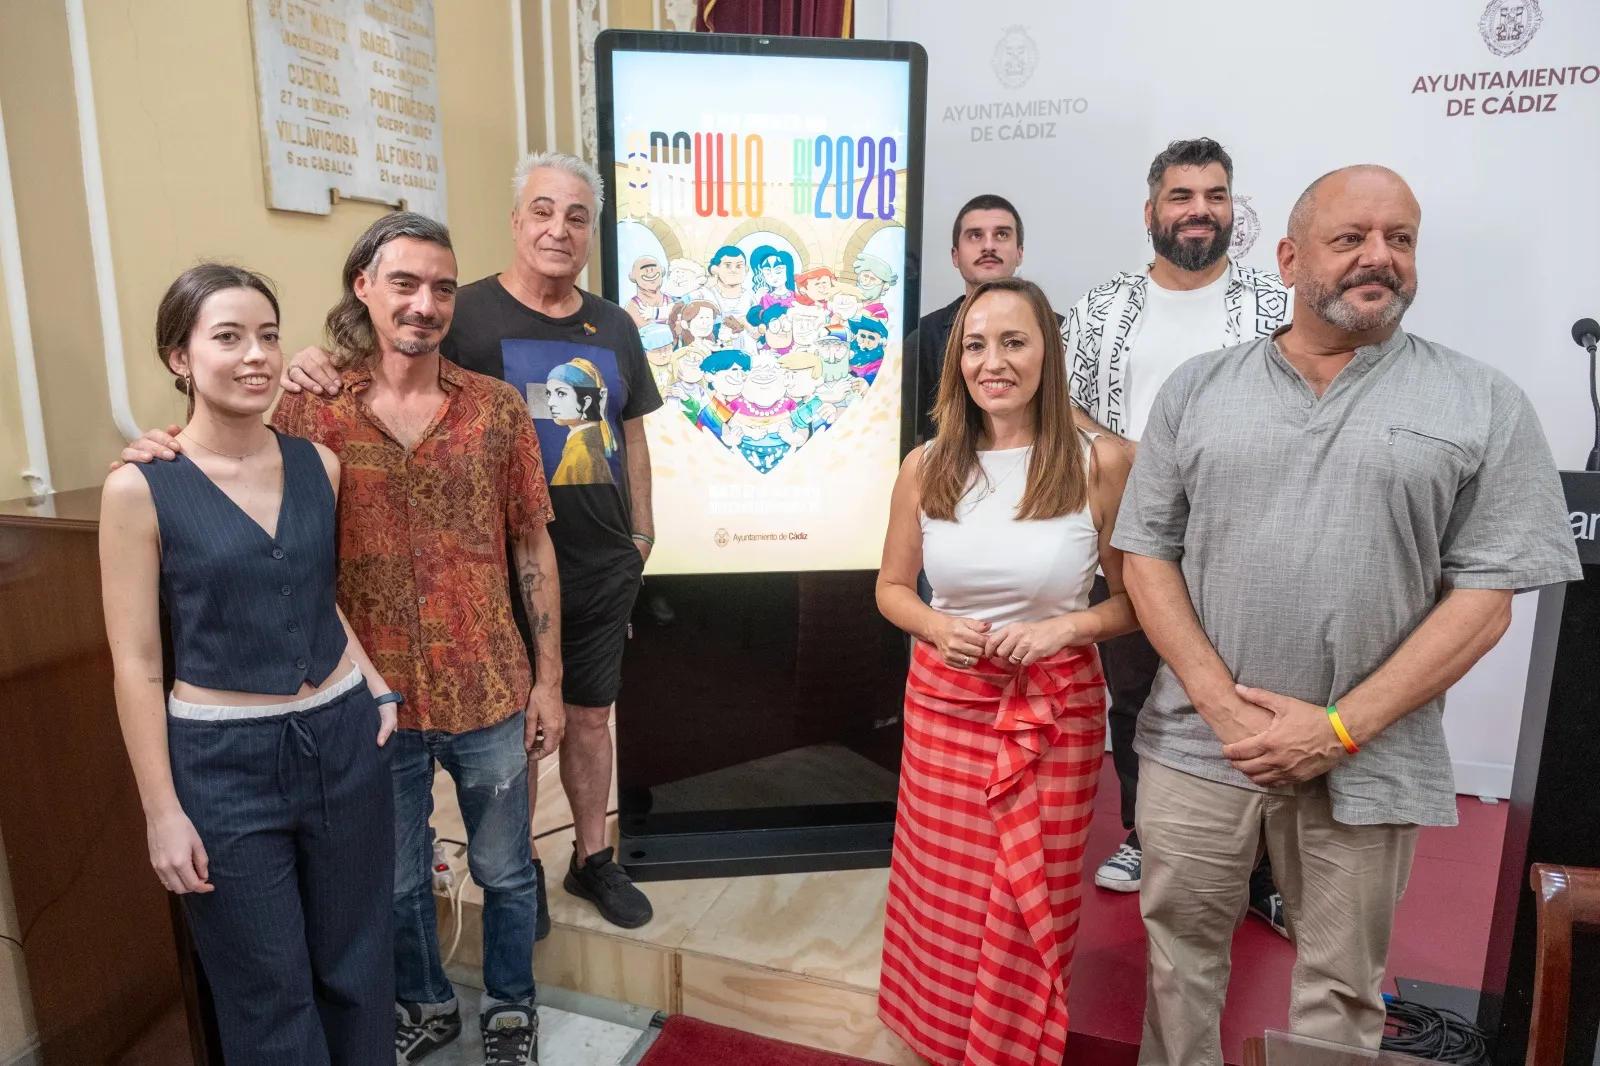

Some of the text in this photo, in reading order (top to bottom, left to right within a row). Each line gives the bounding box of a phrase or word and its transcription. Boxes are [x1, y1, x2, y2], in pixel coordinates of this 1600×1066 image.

[359, 28, 394, 59] ISABEL
[287, 62, 341, 97] CUENCA
[1411, 65, 1600, 94] AYUNTAMIENTO
[280, 89, 293, 106] 27
[296, 97, 309, 110] DE
[942, 97, 1089, 123] AYUNTAMIENTO
[1446, 91, 1558, 117] DE CÁDIZ
[275, 119, 359, 157] VILLAVICIOSA
[970, 119, 1057, 142] DE CÁDIZ
[286, 150, 294, 165] 6
[296, 156, 308, 169] DE
[375, 143, 422, 171] ALFONSO
[815, 134, 897, 220] 2026
[733, 531, 808, 543] Ayuntamiento de Cádiz
